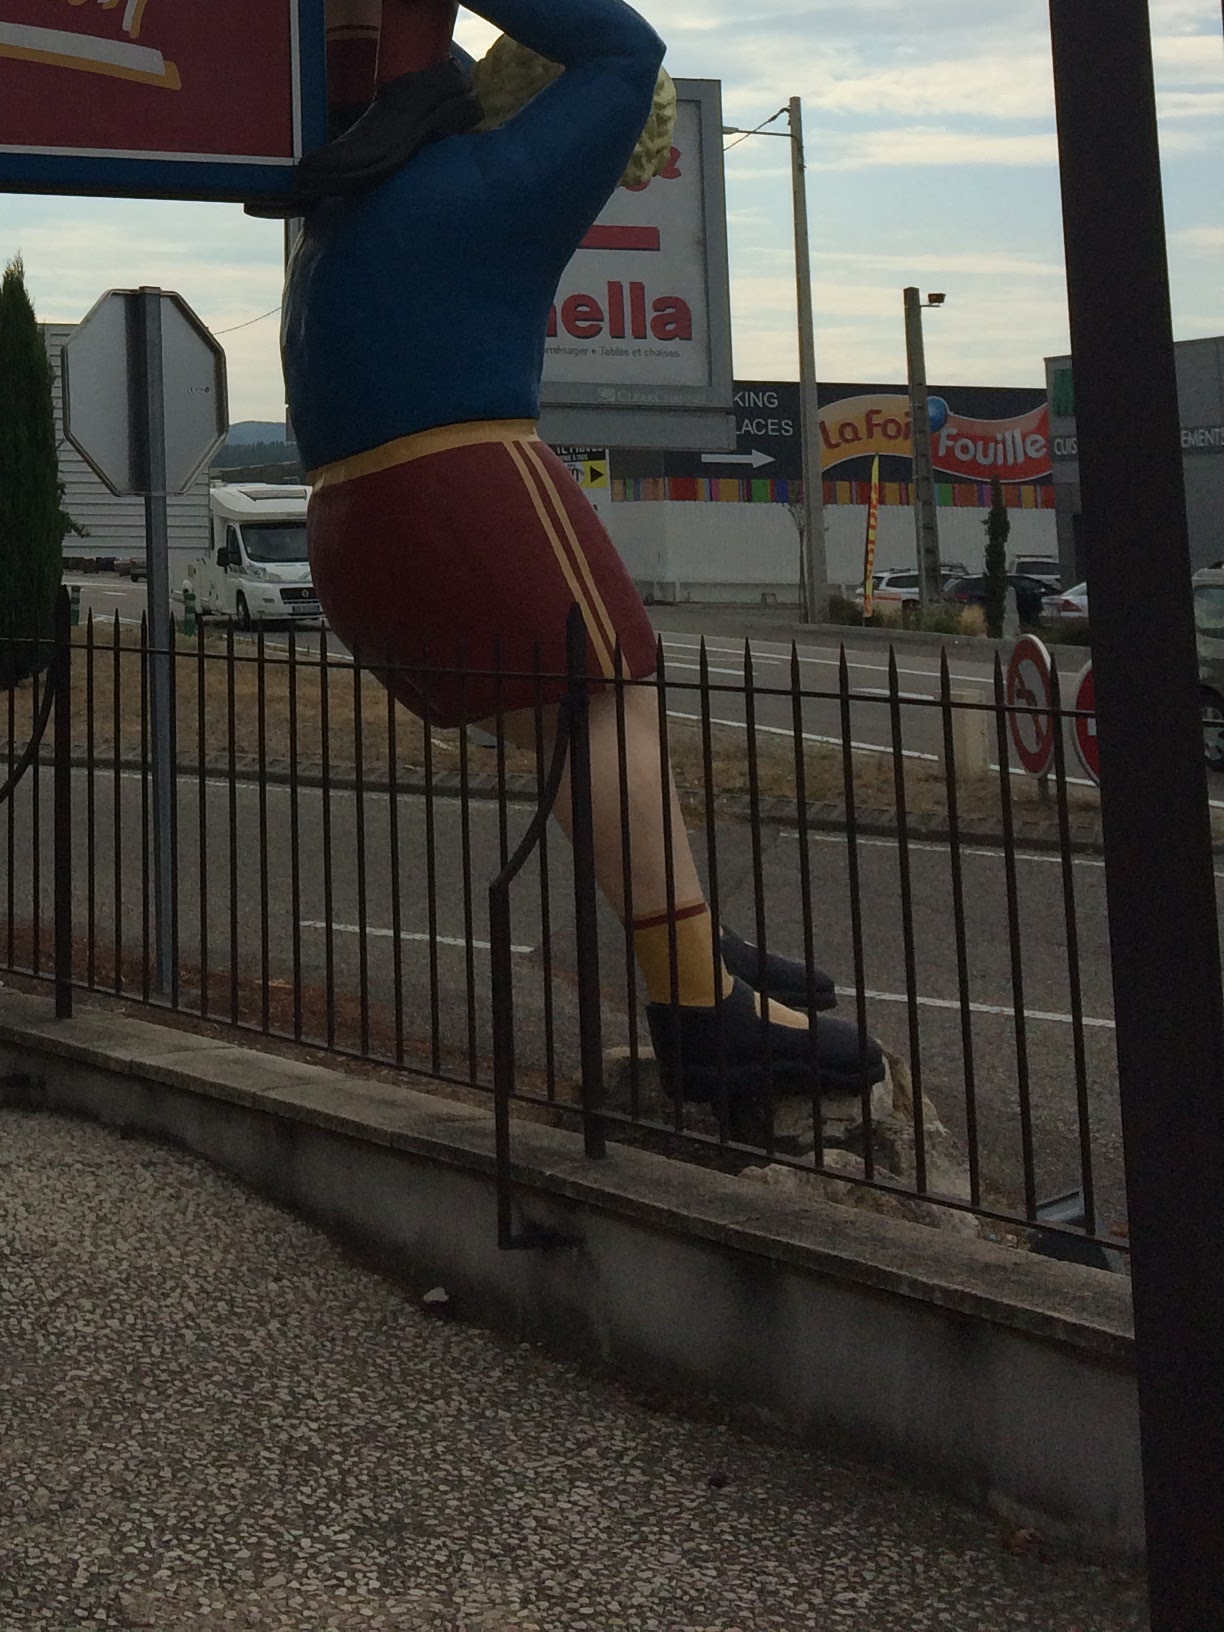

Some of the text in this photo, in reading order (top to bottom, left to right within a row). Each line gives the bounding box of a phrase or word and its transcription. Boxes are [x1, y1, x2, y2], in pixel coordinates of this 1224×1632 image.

[544, 345, 680, 359] ménager Tables et chaises
[736, 418, 794, 436] ACES
[818, 418, 863, 450] La
[937, 426, 1048, 466] Fouille
